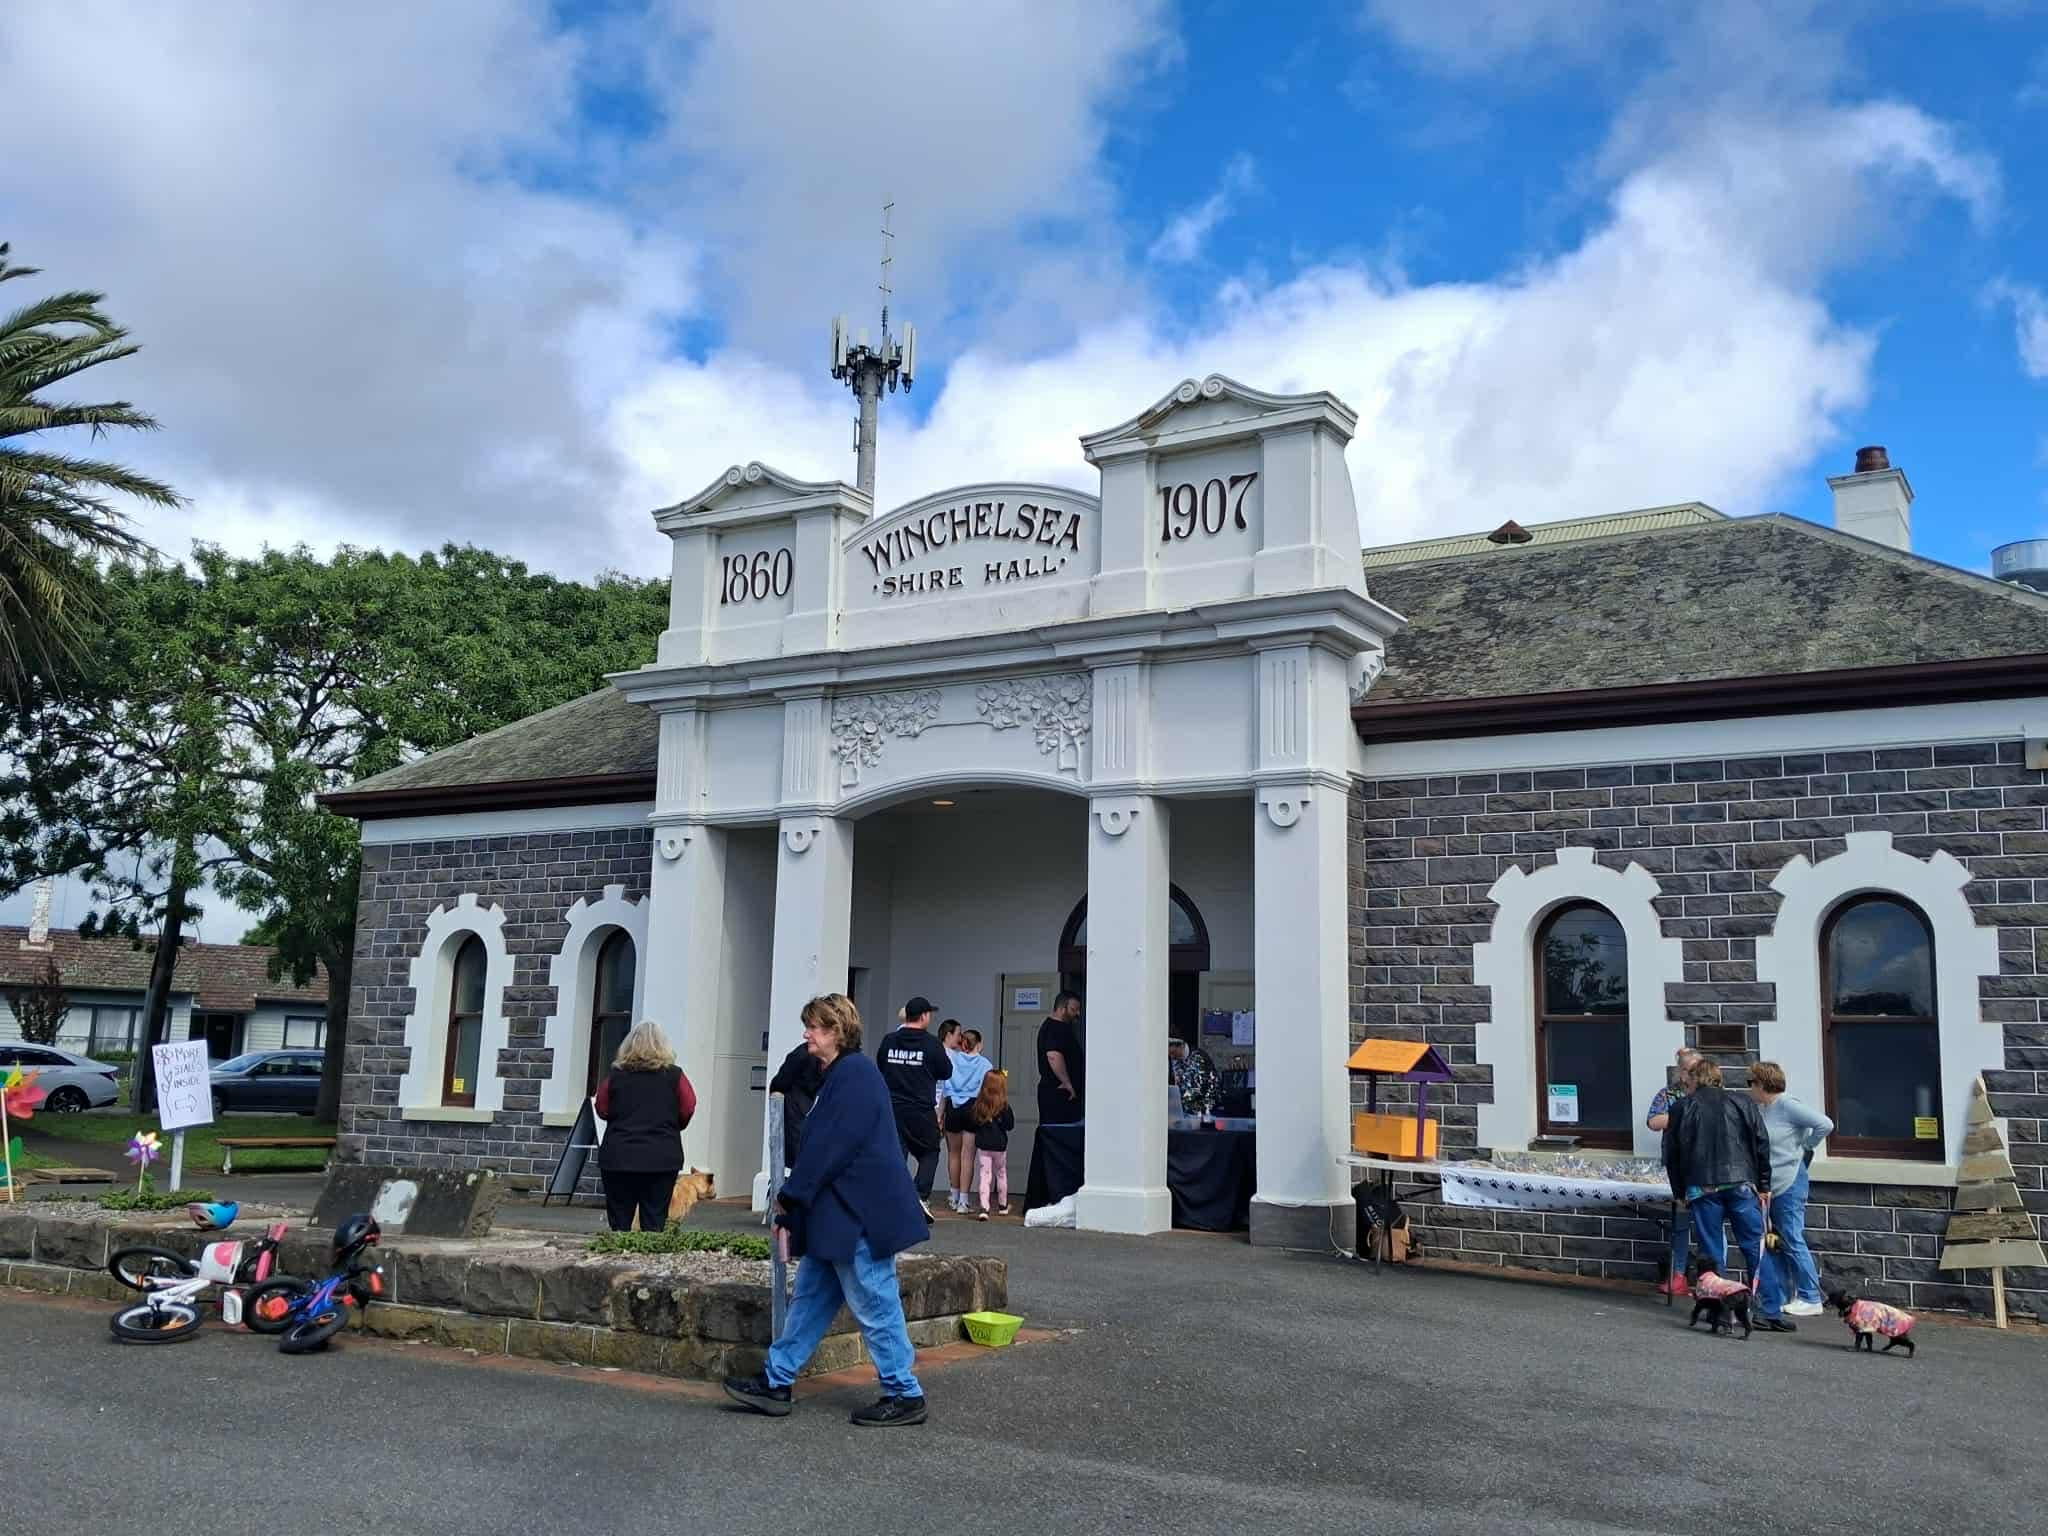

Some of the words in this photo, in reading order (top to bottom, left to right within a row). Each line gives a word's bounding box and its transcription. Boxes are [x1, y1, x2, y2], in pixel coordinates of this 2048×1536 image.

[862, 501, 1081, 578] WINCHELSEA
[1161, 471, 1259, 543] 1907
[721, 547, 795, 606] 1860
